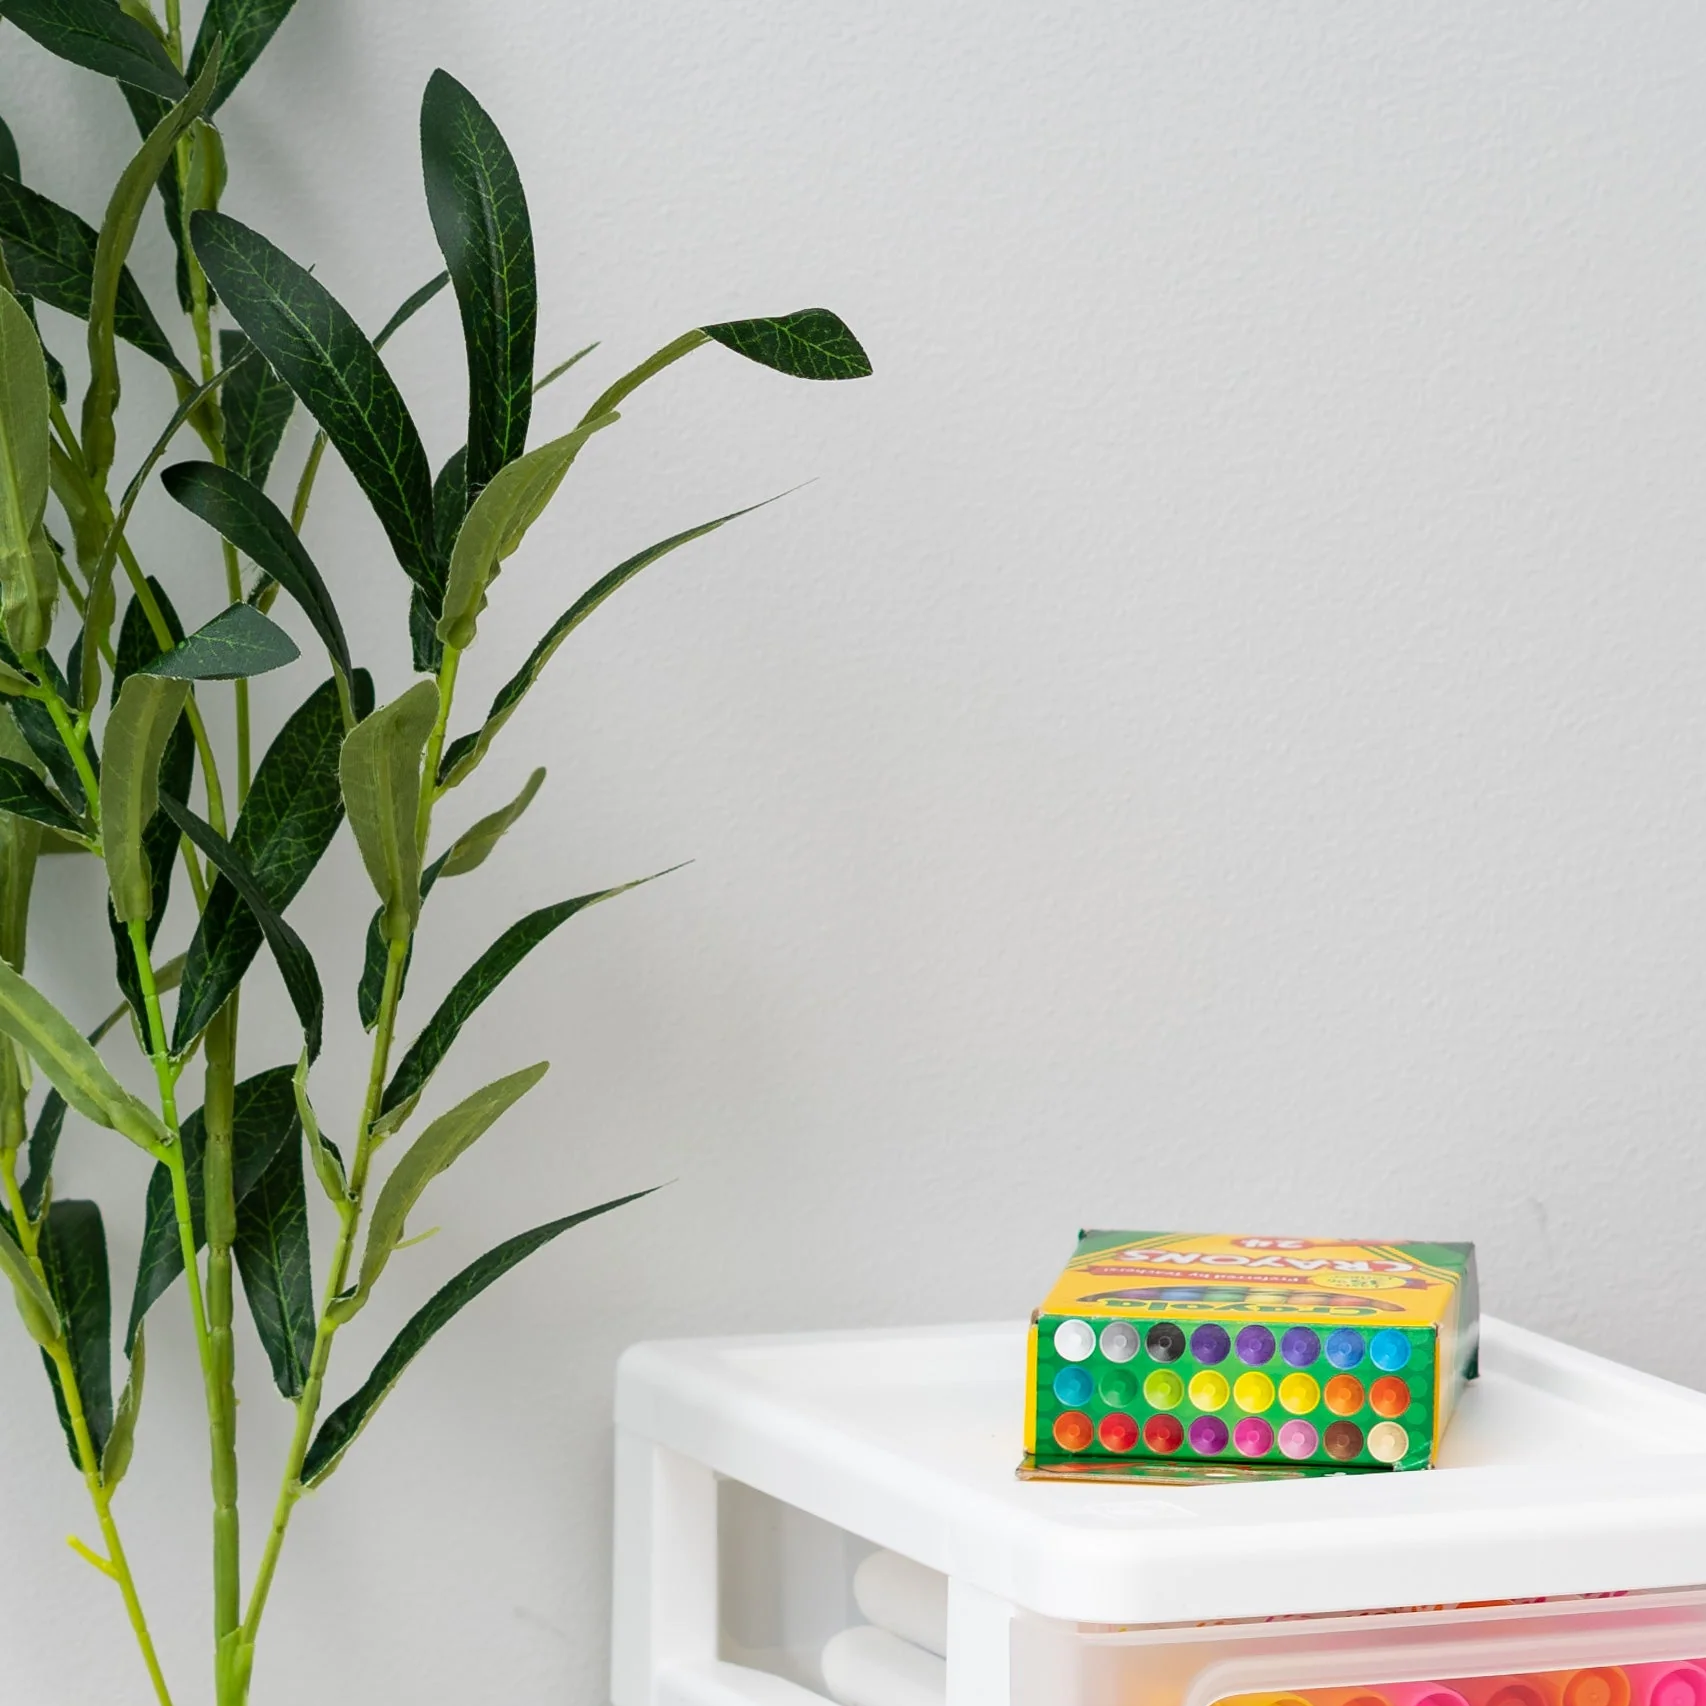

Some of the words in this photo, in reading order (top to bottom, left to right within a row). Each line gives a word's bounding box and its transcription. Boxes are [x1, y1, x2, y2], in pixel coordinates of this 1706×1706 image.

[1242, 1237, 1305, 1250] 24
[1119, 1249, 1414, 1273] CRAYONS
[1187, 1271, 1209, 1281] by
[1214, 1272, 1299, 1284] Preferred
[1105, 1299, 1378, 1317] Crayola
